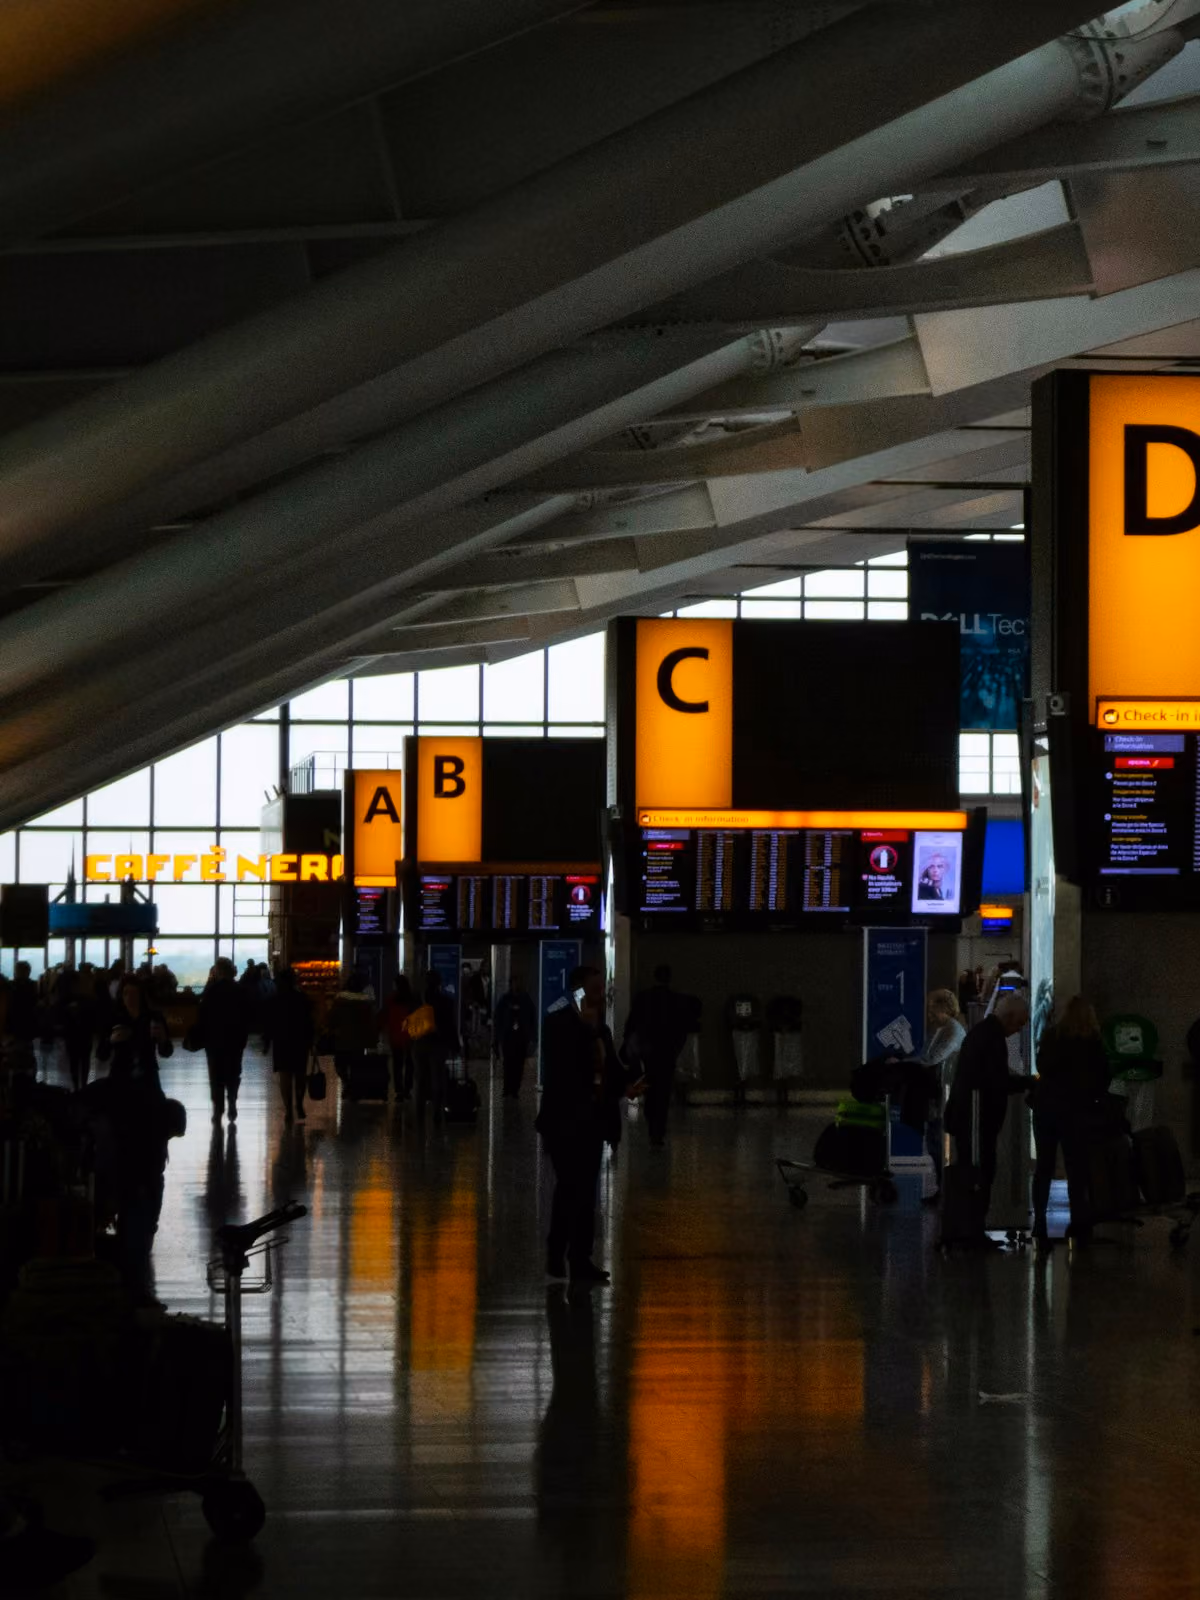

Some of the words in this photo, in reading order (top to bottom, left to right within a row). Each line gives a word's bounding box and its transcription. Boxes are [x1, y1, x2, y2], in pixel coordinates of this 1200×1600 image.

[656, 646, 710, 713] C
[1123, 709, 1190, 722] Check-in
[433, 755, 466, 798] B
[363, 786, 401, 824] A
[895, 969, 905, 1005] 1
